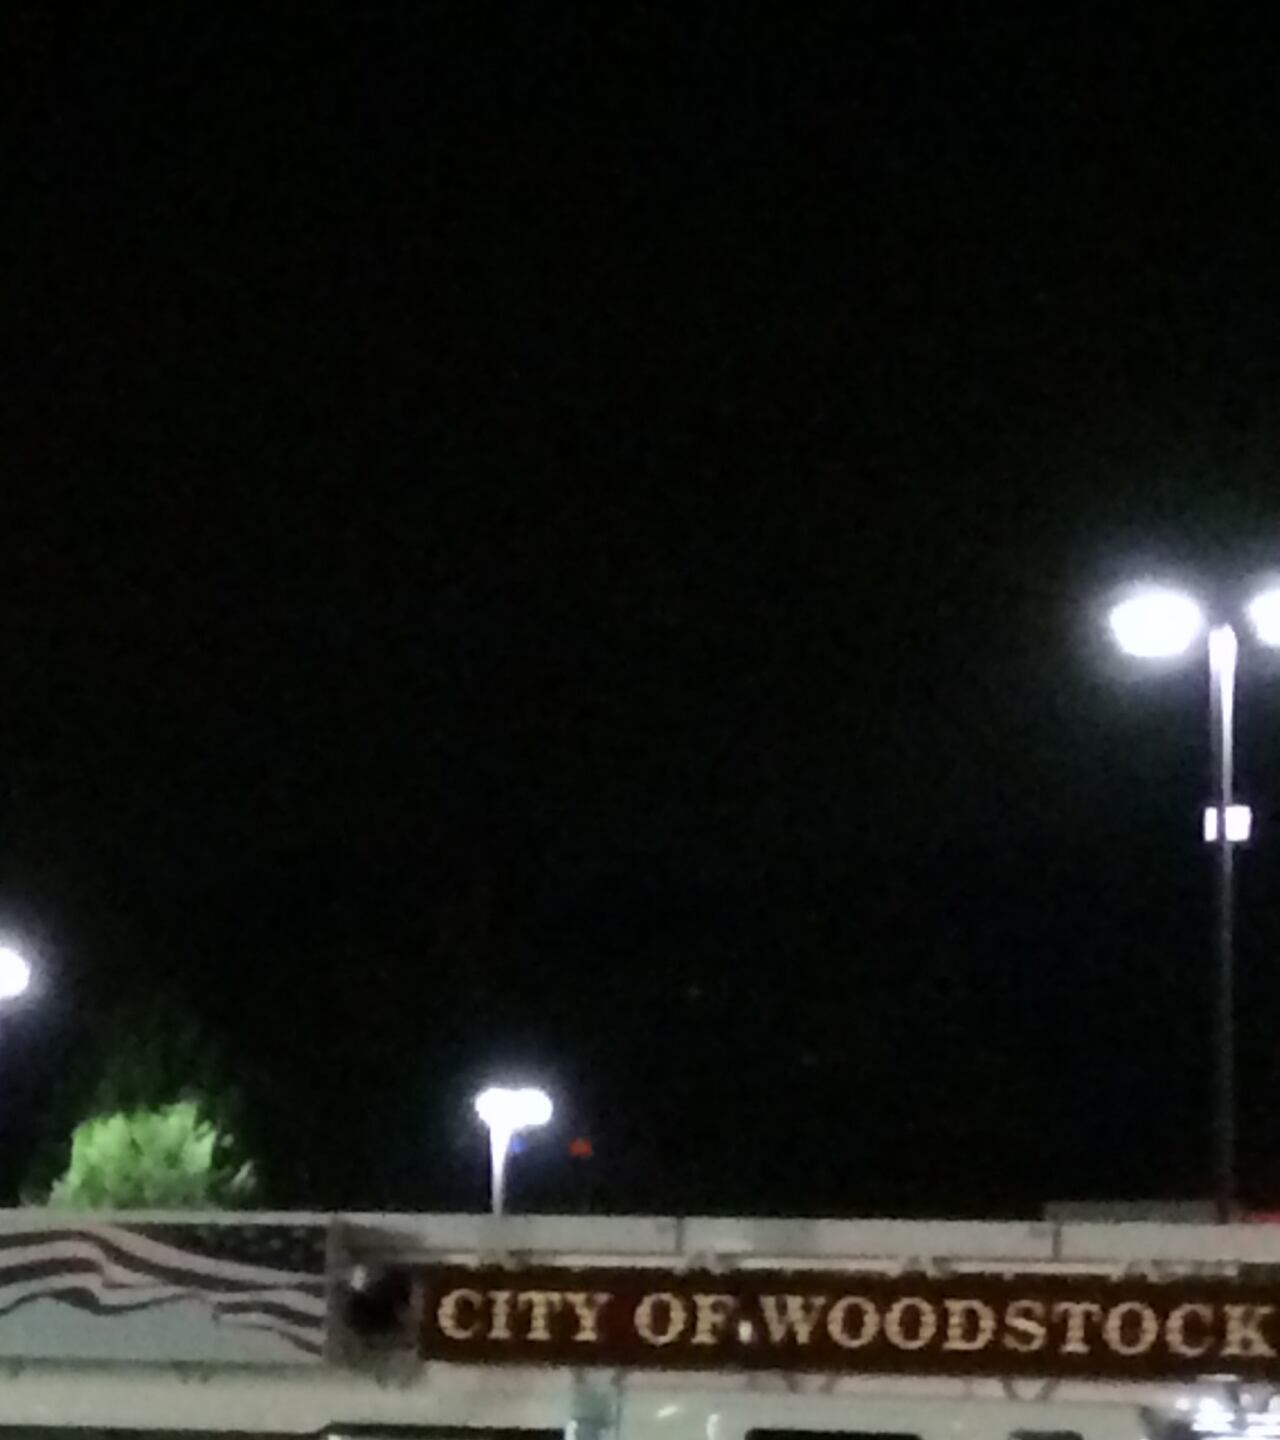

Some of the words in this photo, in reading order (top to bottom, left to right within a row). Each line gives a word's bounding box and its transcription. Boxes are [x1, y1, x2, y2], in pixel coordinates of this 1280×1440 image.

[437, 1287, 614, 1342] CITY
[634, 1291, 738, 1346] OF
[758, 1293, 1279, 1358] WOODSTOCK
